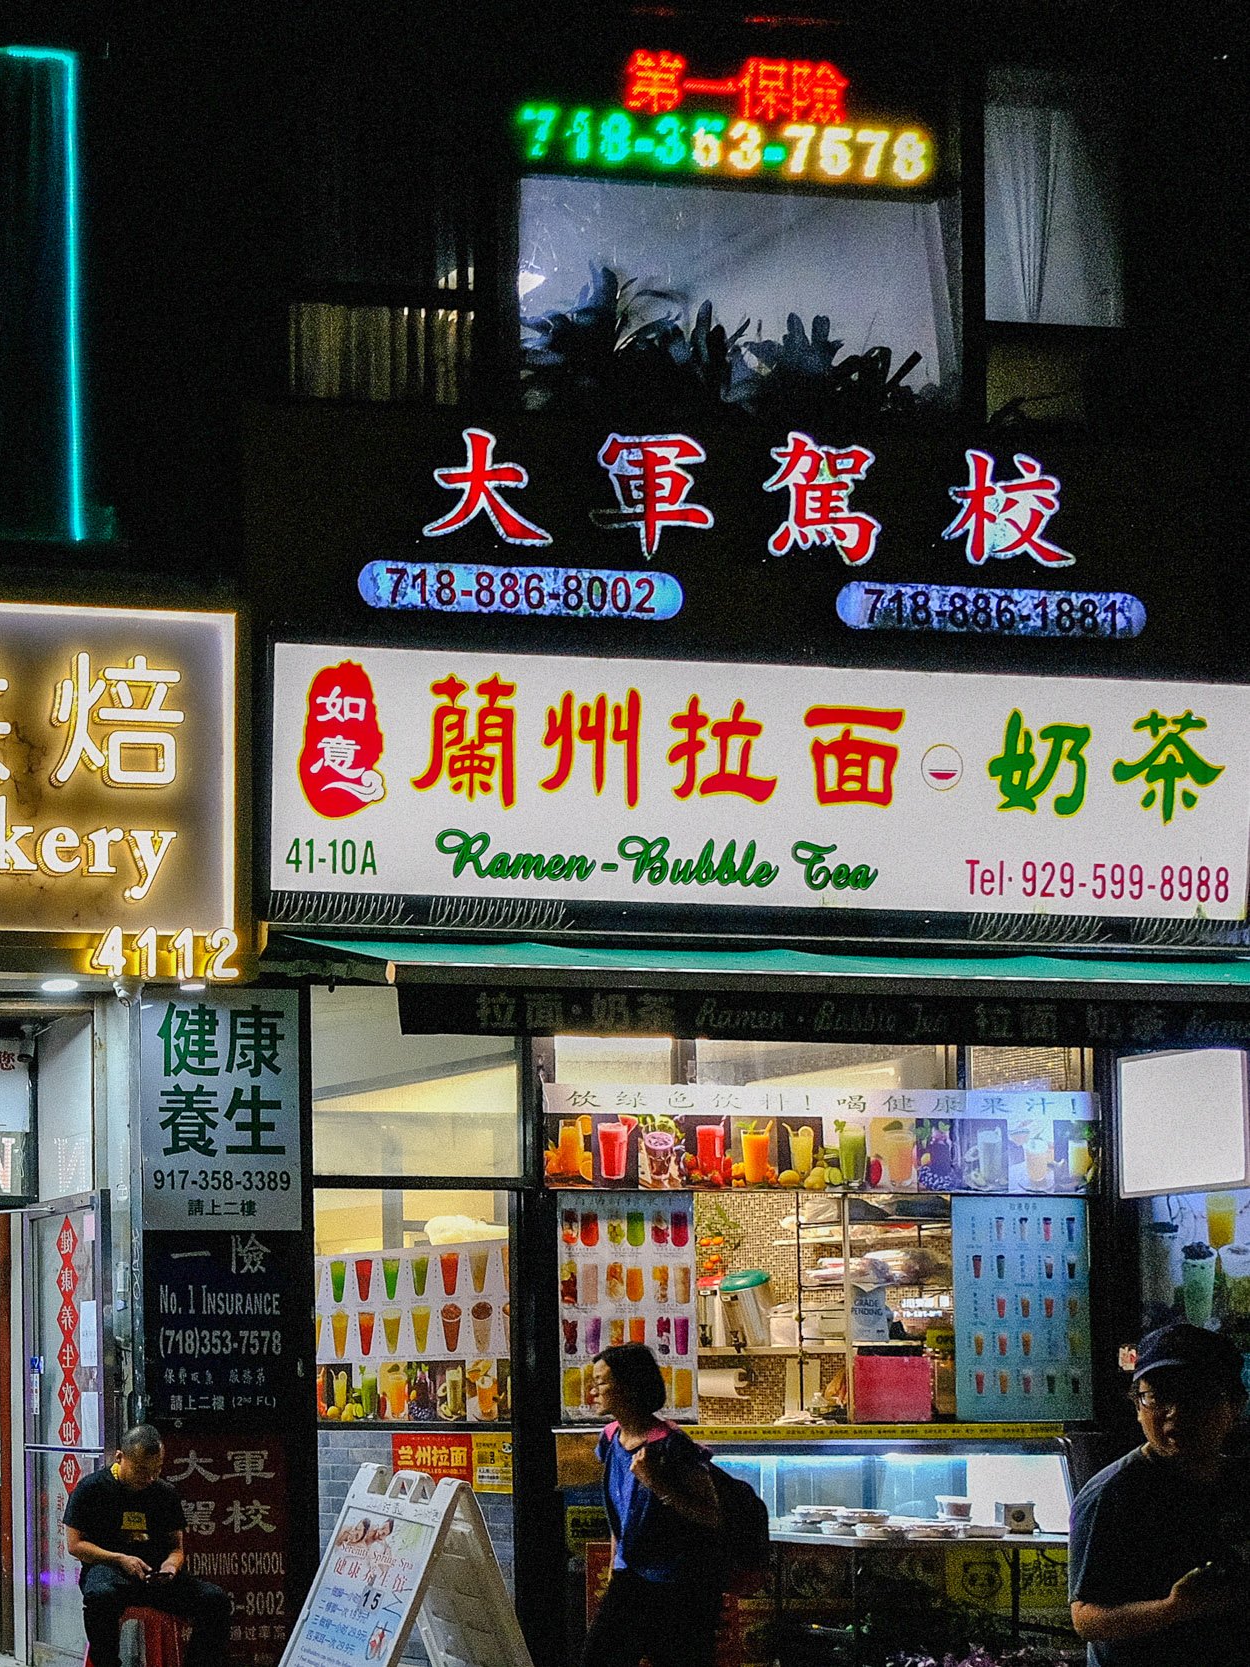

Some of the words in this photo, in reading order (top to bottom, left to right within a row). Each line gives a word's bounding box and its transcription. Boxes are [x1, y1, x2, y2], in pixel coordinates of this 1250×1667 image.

[623, 48, 851, 124] 第一保險
[518, 102, 935, 183] 718-353-7578
[422, 427, 1077, 567] 大軍駕校
[384, 567, 657, 615] 718-886-8002
[863, 588, 1121, 635] 718-886-1881
[310, 684, 370, 780] 如意
[412, 672, 907, 808] 蘭州拉面
[986, 707, 1227, 826] 奶茶
[285, 837, 378, 877] 41-10A
[791, 839, 879, 892] Tea
[1020, 860, 1231, 905] 929-599-8988
[90, 924, 240, 980] 4112
[696, 998, 785, 1030] Ramen
[156, 1002, 286, 1078] 健康
[158, 1083, 287, 1158] 養生
[153, 1168, 292, 1194] 917-358-3389
[187, 1198, 257, 1218] 請上二樓
[188, 1284, 196, 1315] 1
[851, 1307, 883, 1317] PENDING
[853, 1299, 879, 1308] GRADE
[159, 1326, 282, 1359] (718)353-7578
[170, 1394, 225, 1411] 請上二樓
[166, 1449, 276, 1485] 大軍
[397, 1445, 468, 1467] 兰州拉面
[193, 1552, 239, 1576] DRIVING
[241, 1551, 286, 1575] SCHOOL
[371, 1550, 397, 1568] Spring
[400, 1557, 414, 1571] Spa
[362, 1589, 382, 1611] 15
